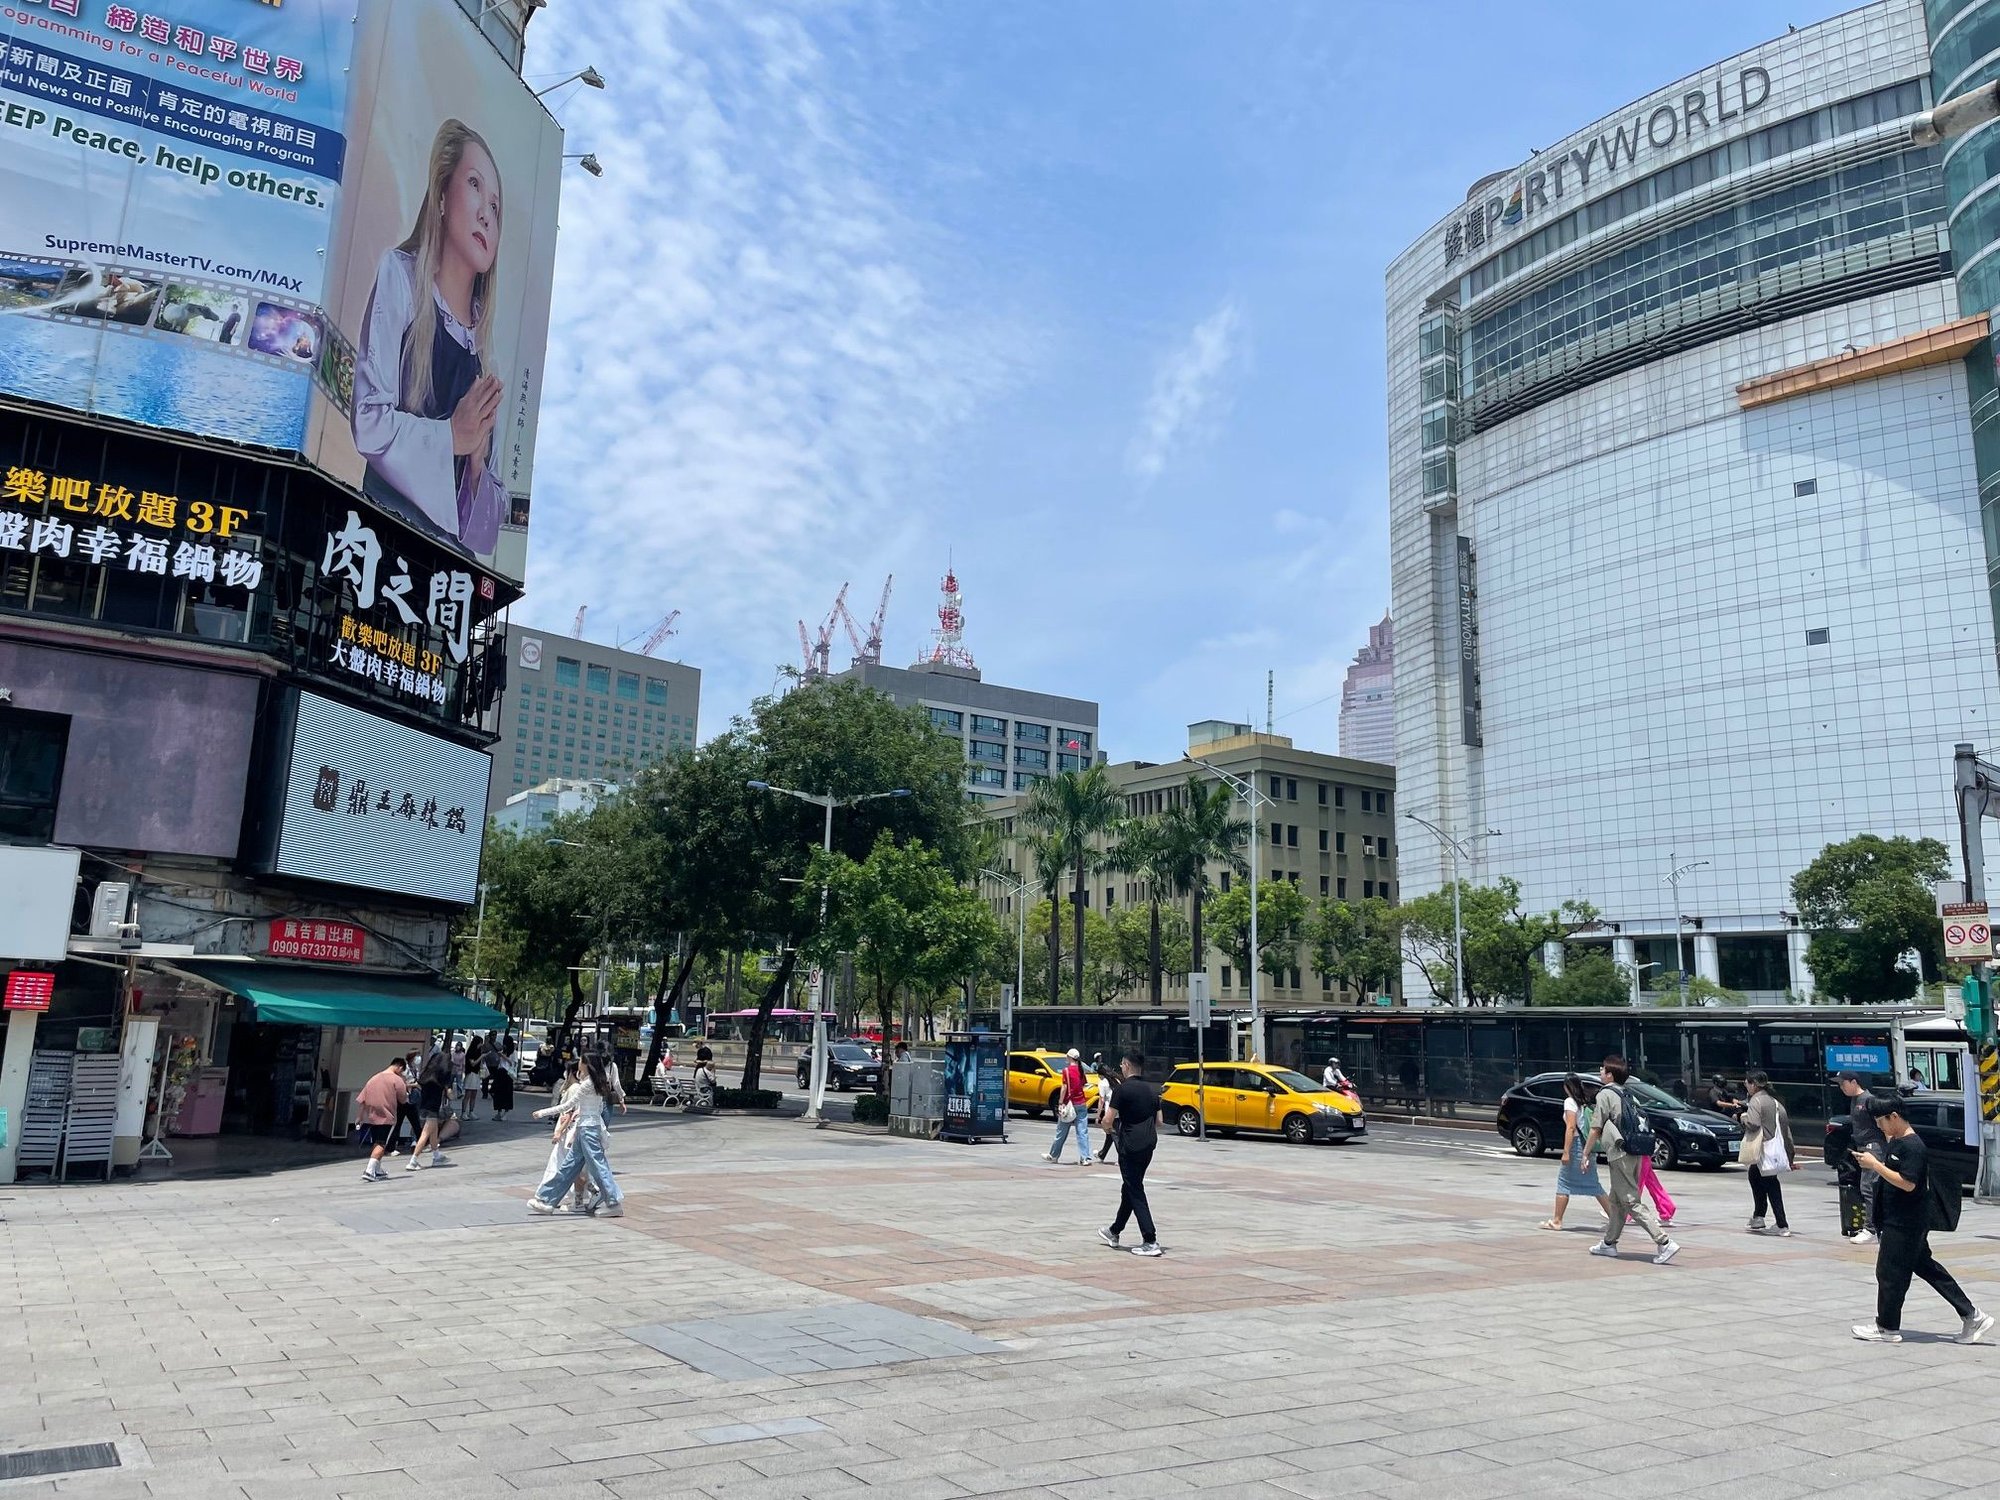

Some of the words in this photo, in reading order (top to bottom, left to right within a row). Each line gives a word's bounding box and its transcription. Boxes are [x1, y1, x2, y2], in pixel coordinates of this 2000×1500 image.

[0, 5, 113, 51] ogramming
[119, 41, 143, 56] for
[148, 53, 160, 64] a
[166, 55, 243, 88] Peaceful
[249, 79, 298, 103] World
[106, 4, 304, 82] 締造和平世界
[27, 76, 68, 97] News
[73, 90, 102, 107] and
[105, 99, 160, 123] Positive
[164, 116, 252, 150] Encouraging
[257, 141, 314, 166] Program
[0, 101, 46, 129] EP
[52, 116, 147, 164] Peace,
[155, 146, 219, 185] help
[227, 171, 325, 209] others.
[45, 234, 303, 293] SupremeMasterTV.com/MAX
[186, 501, 249, 538] 3F
[321, 510, 475, 664] 肉之間
[328, 638, 447, 705] 大盤肉幸福鍋物
[341, 614, 416, 668] 歡樂吧放題
[421, 649, 443, 675] 3F
[272, 939, 299, 954] 0909
[300, 942, 339, 958] 673378
[284, 921, 354, 943] 廣告牆出租
